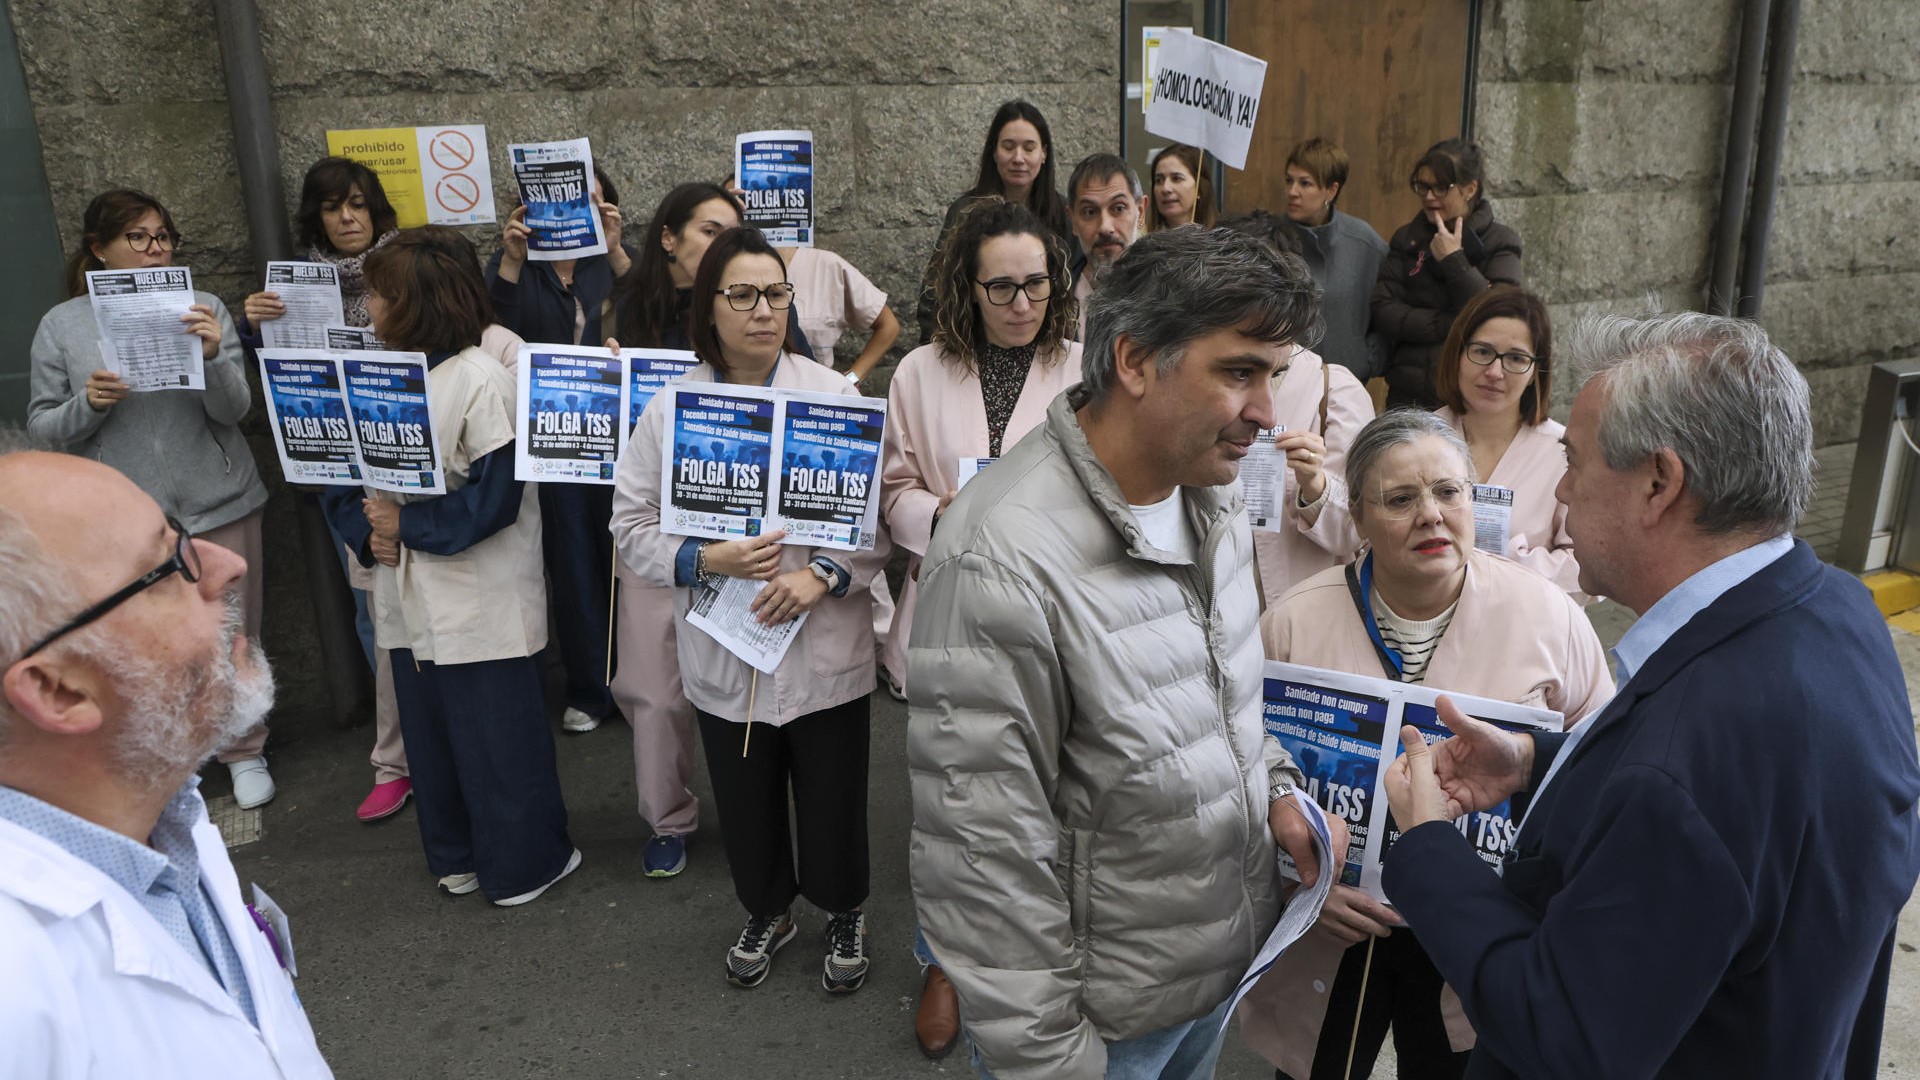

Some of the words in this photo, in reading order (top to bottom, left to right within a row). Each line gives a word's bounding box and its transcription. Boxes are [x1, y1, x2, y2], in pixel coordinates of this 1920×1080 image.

[1153, 67, 1234, 128] ¡HOMOLOGACIÓN,
[1236, 94, 1256, 128] YA!
[343, 142, 404, 155] prohibido
[526, 184, 547, 203] TSS
[547, 181, 582, 203] FOLGA
[745, 189, 780, 208] FOLGA
[784, 189, 804, 207] TSS
[134, 271, 167, 285] HUELGA
[168, 271, 184, 283] TSS
[293, 266, 318, 277] HUELGA
[320, 267, 333, 278] TSS
[552, 357, 575, 366] Sanidade
[588, 361, 607, 369] cumpre
[572, 370, 586, 378] paga
[699, 397, 723, 409] Sanidade
[724, 400, 734, 409] non
[736, 403, 757, 412] cumpre
[683, 410, 706, 420] Facenda
[708, 412, 719, 420] non
[720, 412, 734, 422] paga
[809, 407, 834, 418] Sanidade
[835, 410, 846, 419] non
[847, 412, 868, 422] cumpre
[284, 417, 323, 438] FOLGA
[324, 418, 348, 439] TSS
[359, 420, 396, 444] FOLGA
[397, 424, 424, 446] TSS
[537, 412, 581, 434] FOLGA
[586, 413, 611, 437] TSS
[792, 419, 817, 429] Facenda
[818, 422, 829, 430] non
[830, 423, 845, 431] paga
[588, 436, 614, 444] Sanitarios
[681, 458, 727, 486] FOLGA
[732, 462, 760, 489] TSS
[676, 482, 700, 492] Técnicos
[702, 485, 732, 495] Superiores
[734, 488, 763, 497] Sanitarios
[789, 467, 836, 495] FOLGA
[841, 470, 867, 498] TSS
[784, 492, 810, 501] Técnicos
[811, 494, 842, 503] Superiores
[1476, 488, 1499, 498] HUELGA
[1501, 490, 1512, 499] TSS
[1285, 686, 1320, 703] Sanidade
[1321, 694, 1336, 707] non
[1338, 699, 1368, 714] cumpre
[1263, 703, 1296, 717] Facenda
[1298, 708, 1312, 719] non
[1315, 712, 1334, 724] paga
[1264, 718, 1306, 738] Consellerías
[1308, 730, 1316, 740] de
[1318, 732, 1338, 748] Saúde
[1340, 739, 1381, 759] ignórannos
[1327, 782, 1365, 821] TSS
